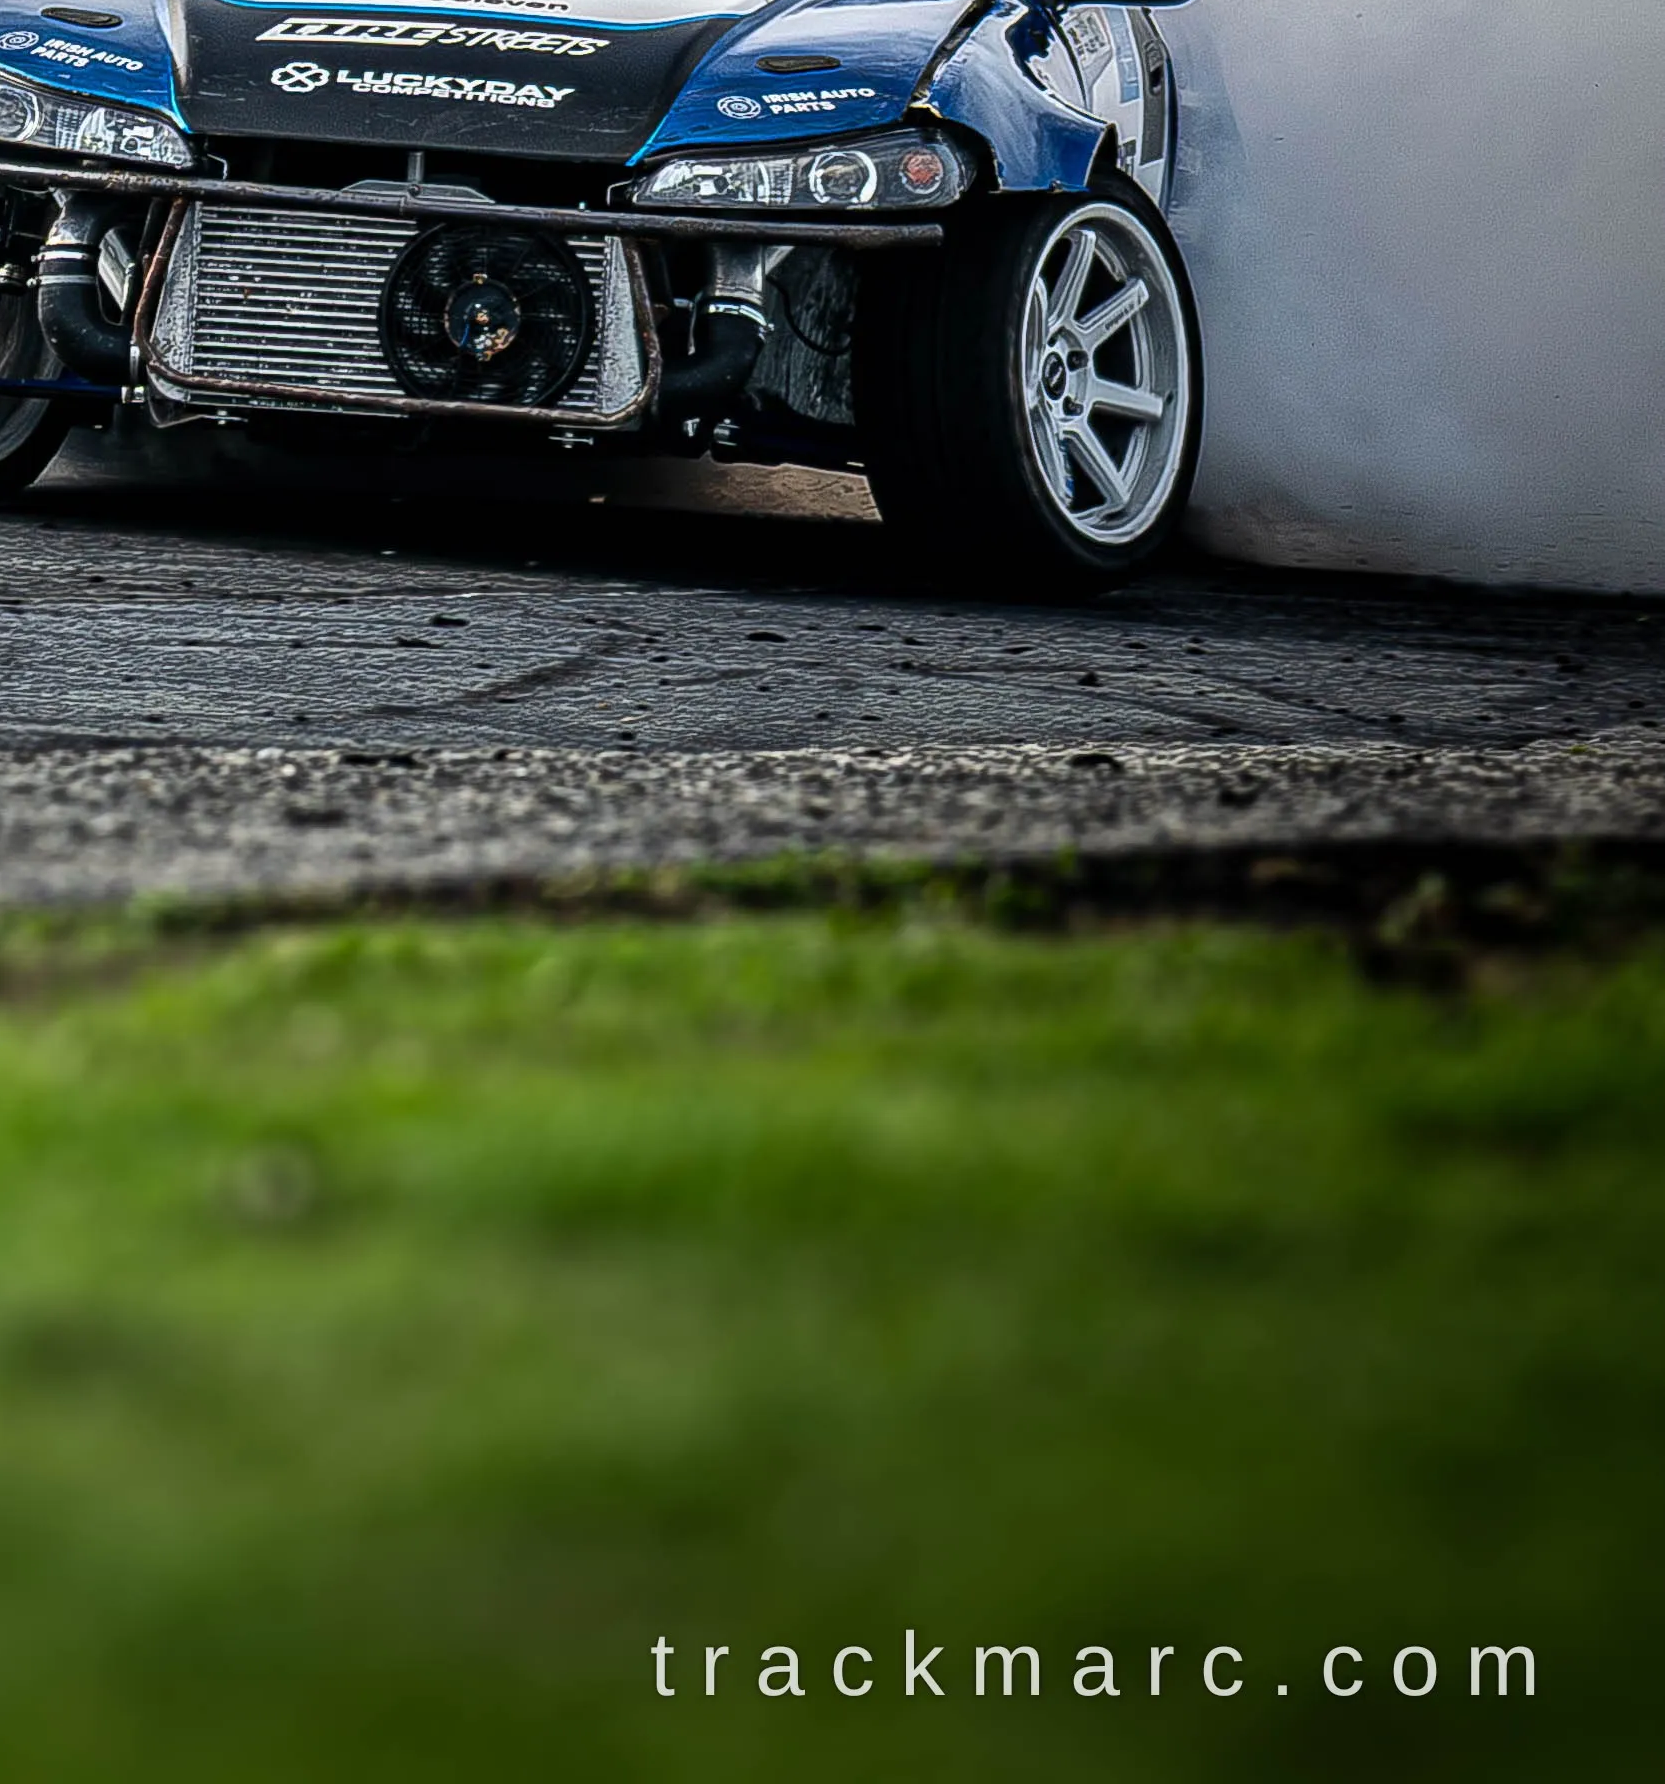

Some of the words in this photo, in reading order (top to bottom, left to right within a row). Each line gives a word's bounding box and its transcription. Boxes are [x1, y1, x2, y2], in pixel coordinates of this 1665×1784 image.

[31, 46, 89, 67] PARTS
[43, 38, 95, 57] IRISH
[91, 51, 144, 71] AUTO
[336, 69, 576, 102] LUCKYDAY
[352, 83, 556, 108] COMPETITIONS
[762, 91, 817, 104] IRISH
[820, 88, 876, 100] AUTO
[770, 101, 836, 115] PARTS
